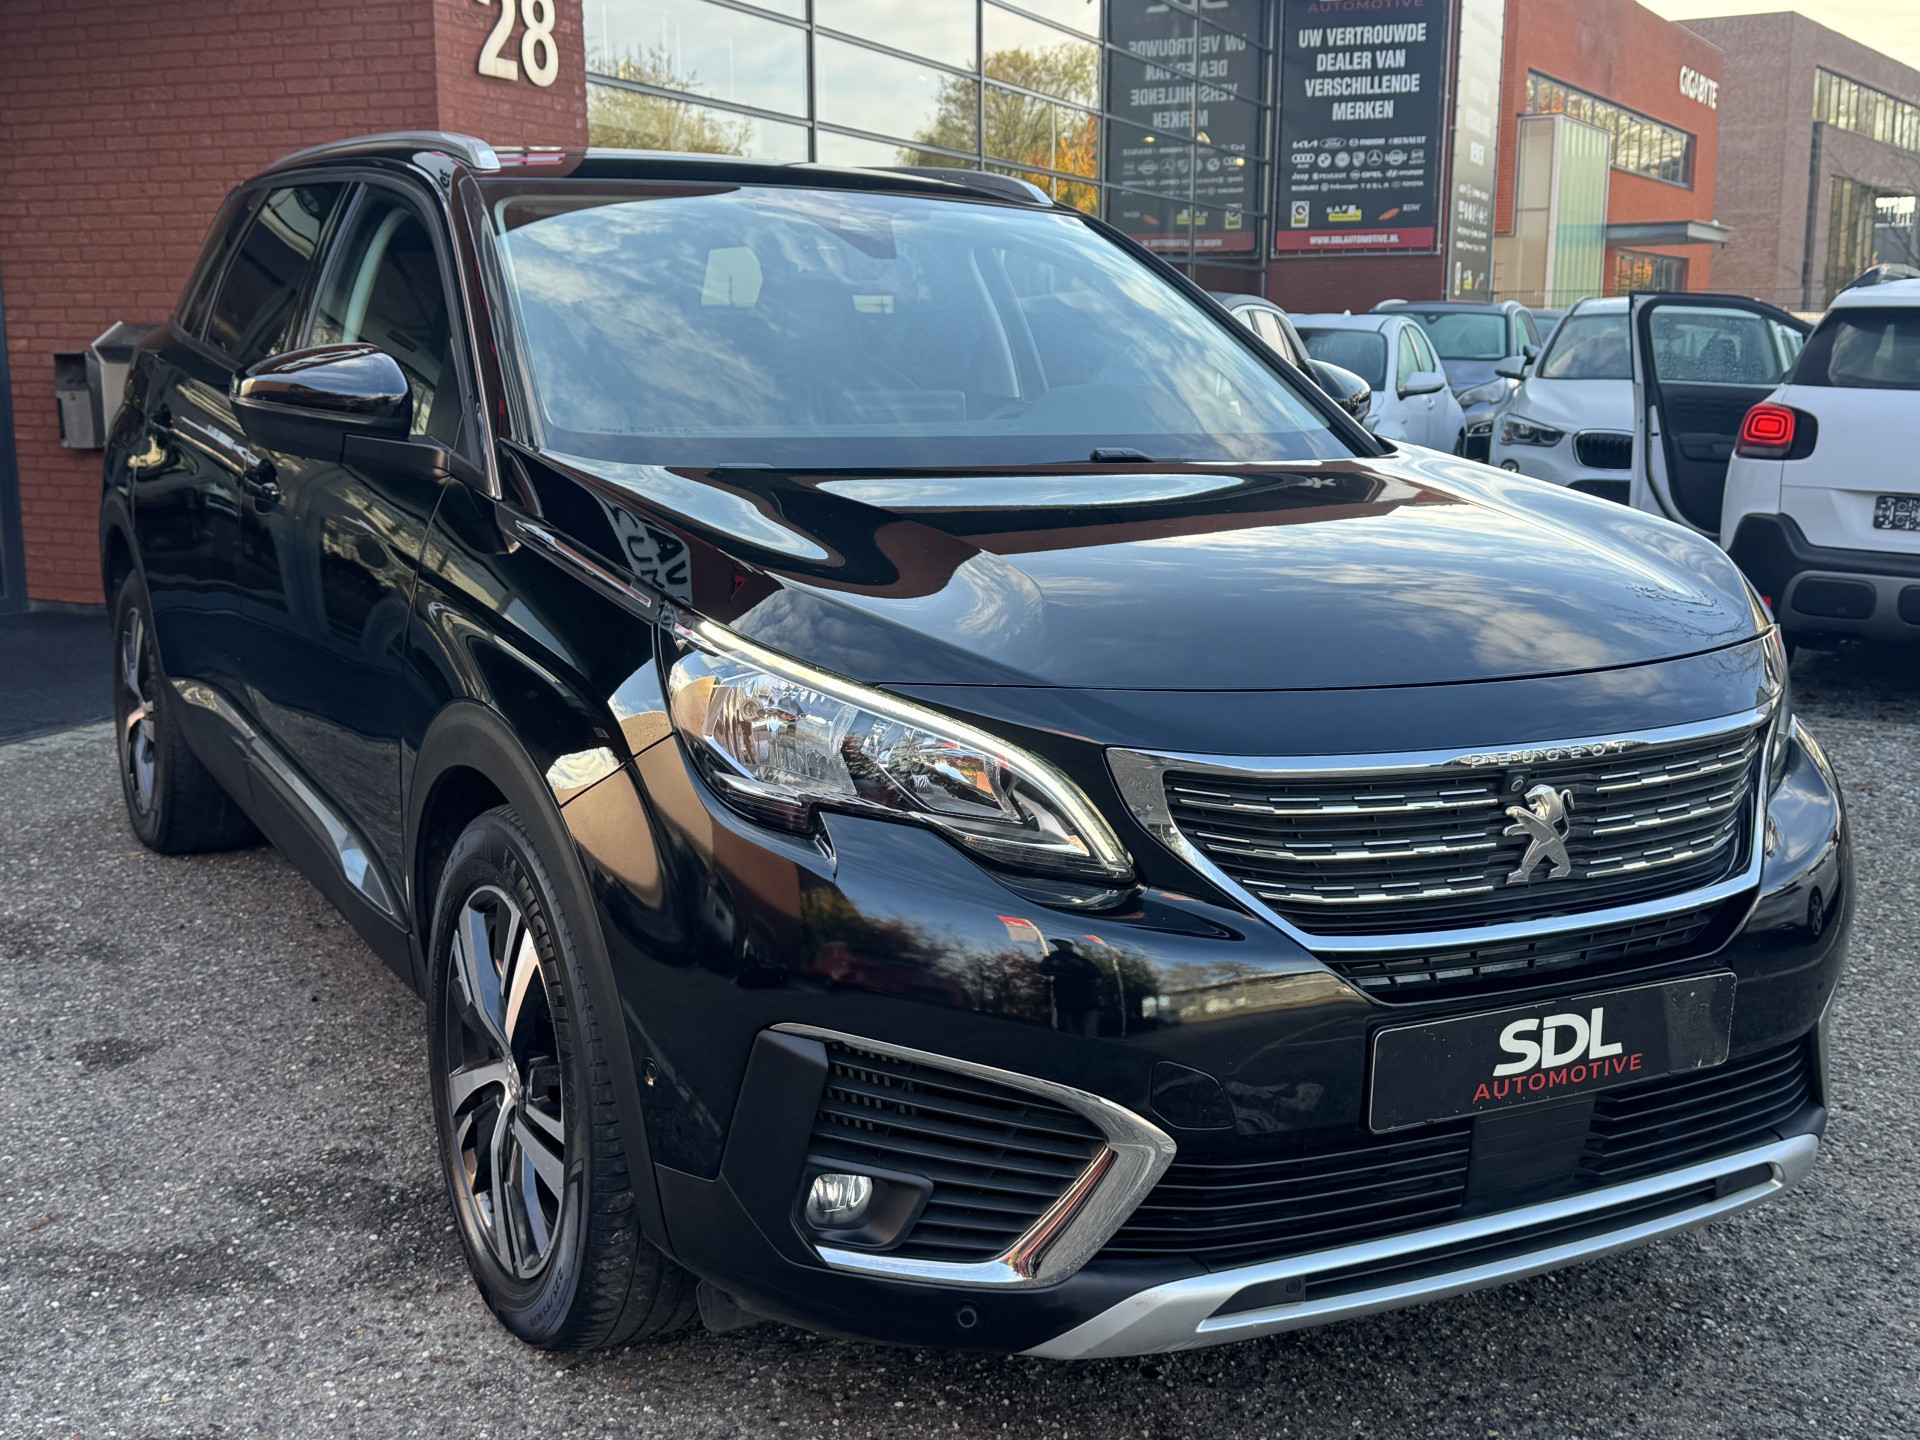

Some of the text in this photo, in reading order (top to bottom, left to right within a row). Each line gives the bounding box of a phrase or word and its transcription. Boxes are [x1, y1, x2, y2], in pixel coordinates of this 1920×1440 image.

[1308, 0, 1424, 13] AUTOMOTIVE
[478, 0, 559, 87] 28
[1299, 22, 1427, 48] UW VERTROUWDE
[1317, 49, 1406, 72] DEALER VAN
[1305, 73, 1420, 97] VERSCHILLENDE
[1680, 65, 1719, 110] GIGABYTE
[1332, 100, 1394, 121] MERKEN
[1470, 741, 1627, 768] PEUGEOT
[515, 875, 576, 1058] MICHELIN
[1492, 1007, 1623, 1077] SDL
[1473, 1053, 1643, 1103] AUTOMOTIVE
